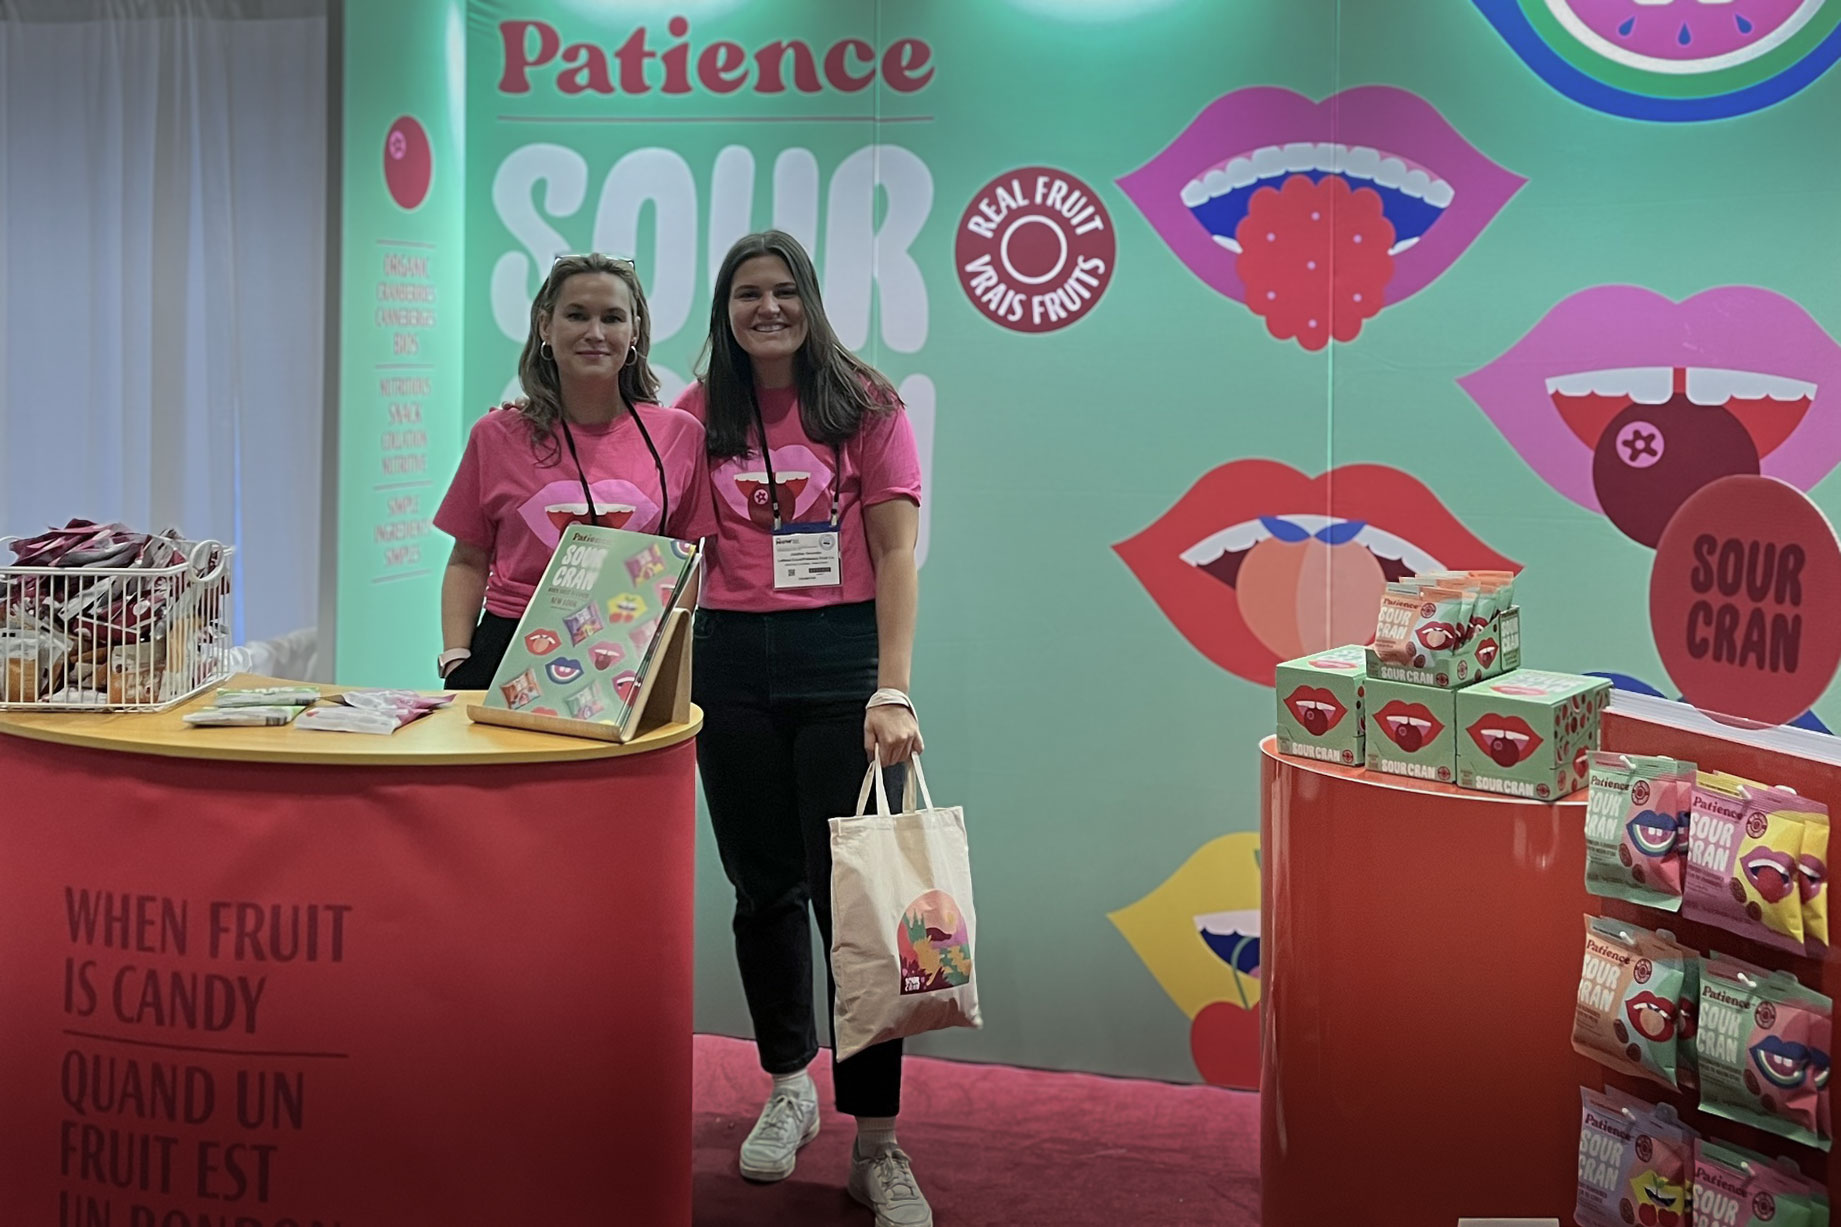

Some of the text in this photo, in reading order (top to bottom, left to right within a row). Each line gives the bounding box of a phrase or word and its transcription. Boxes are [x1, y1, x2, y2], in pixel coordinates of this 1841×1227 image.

[497, 16, 935, 95] Patience
[967, 175, 1105, 239] REAL FRUIT
[964, 253, 1106, 325] VRAIS FRUITS
[552, 566, 599, 591] CRAN
[1690, 534, 1806, 607] SOUR
[1377, 622, 1408, 640] CRAN
[1379, 606, 1412, 625] SOUR
[1686, 600, 1803, 674] CRAN
[1380, 666, 1406, 681] SOUR
[1406, 670, 1434, 685] CRAN
[1292, 742, 1315, 758] SOUR
[1315, 746, 1341, 762] CRAN
[1381, 759, 1407, 775] SOUR
[1407, 763, 1436, 779] CRAN
[1475, 775, 1504, 791] SOUR
[1504, 779, 1534, 796] CRAN
[1591, 775, 1630, 791] Patience
[1693, 796, 1744, 820] Patience
[65, 886, 353, 962] WHEN FRUIT
[1587, 940, 1631, 965] Patience
[64, 957, 268, 1034] IS CANDY
[1578, 979, 1615, 1013] RAN
[1702, 985, 1750, 1009] Patience
[1699, 1002, 1741, 1038] SOUR
[1696, 1028, 1738, 1064] CRAN
[61, 1050, 304, 1129] QUAND UN
[1585, 1113, 1631, 1141] Patience
[60, 1120, 278, 1203] FRUIT EST
[1580, 1130, 1624, 1168] SOUR
[1696, 1167, 1748, 1198] Patience
[1692, 1183, 1739, 1226] SOUR
